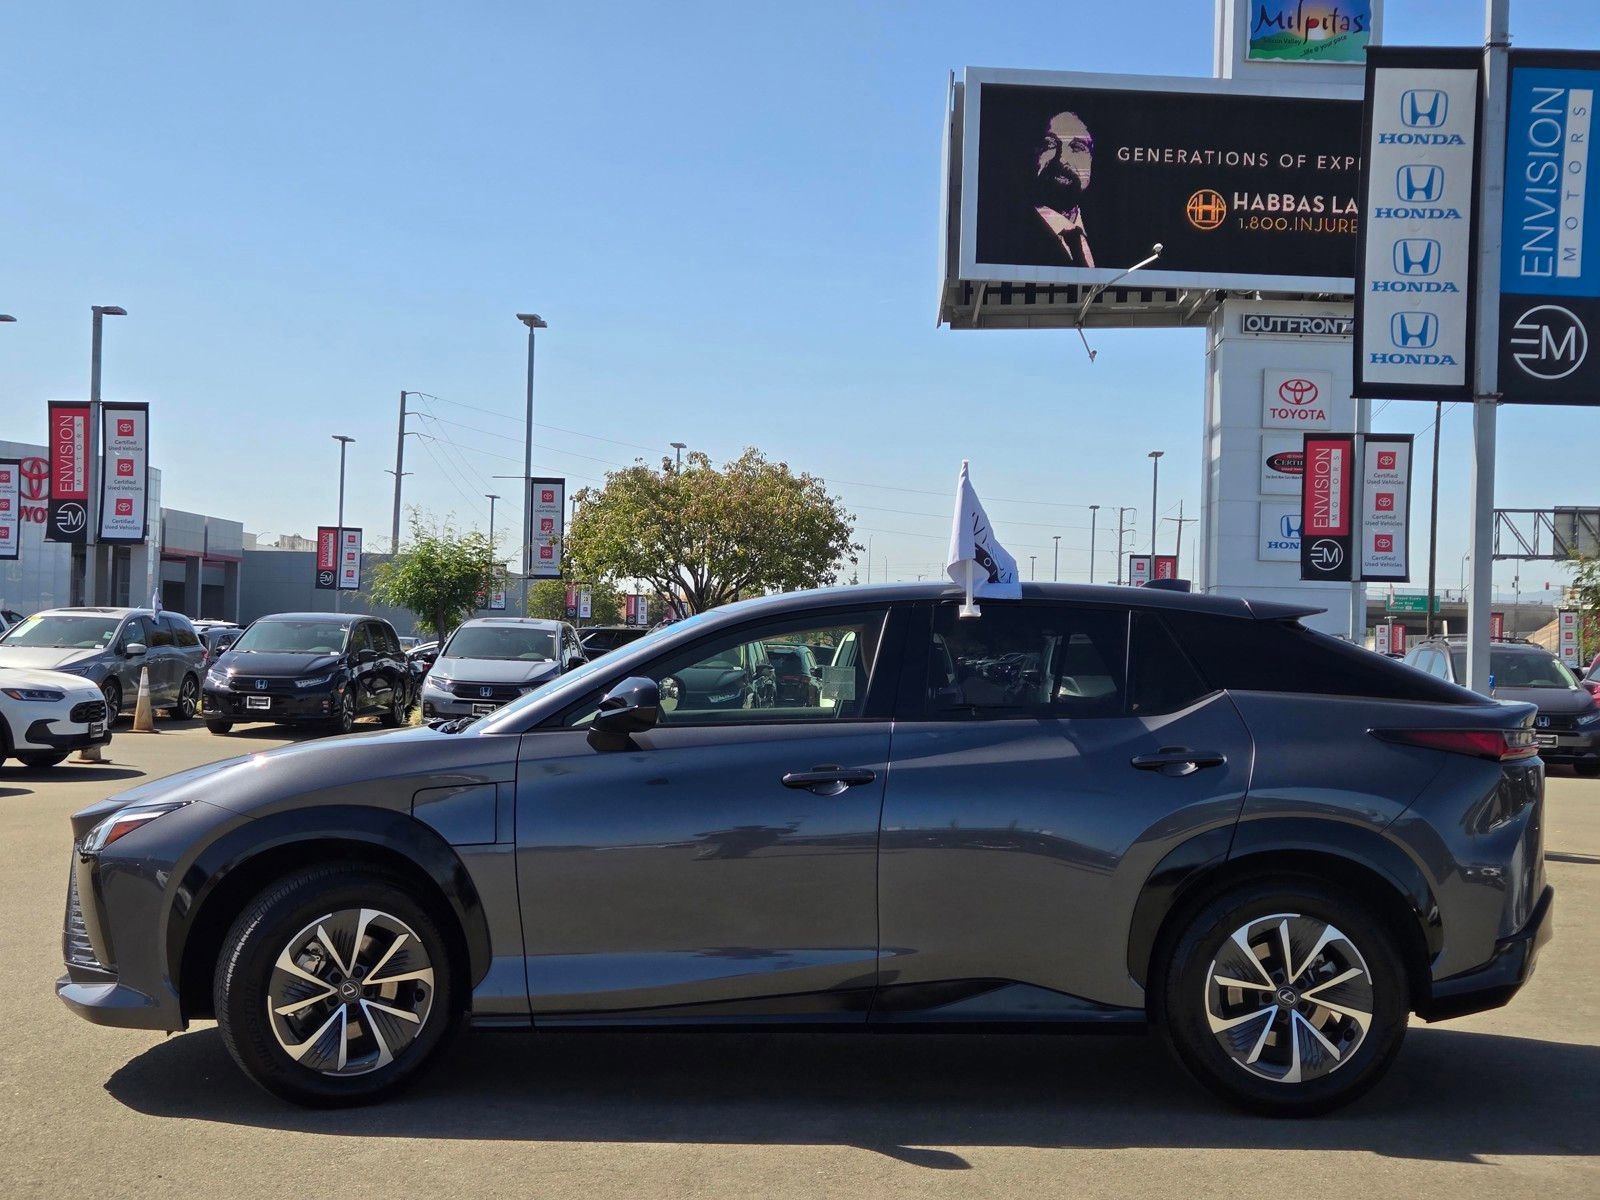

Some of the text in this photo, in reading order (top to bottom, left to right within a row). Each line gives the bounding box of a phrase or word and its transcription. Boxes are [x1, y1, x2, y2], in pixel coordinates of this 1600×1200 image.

[1254, 0, 1364, 44] Milpitas
[1378, 133, 1466, 146] HONDA
[1117, 146, 1361, 172] GENERATIONS OF EXP
[1520, 87, 1565, 277] ENVISION
[1563, 106, 1587, 262] MOTORS
[1233, 191, 1325, 214] HABBAS
[1375, 207, 1462, 220] HONDA
[1371, 281, 1460, 293] HONDA
[1370, 352, 1458, 366] HONDA
[1270, 408, 1326, 420] TOYOTA
[59, 415, 74, 492] ENVISION
[1313, 448, 1331, 528] ENVISION
[1332, 455, 1340, 521] MOTORS
